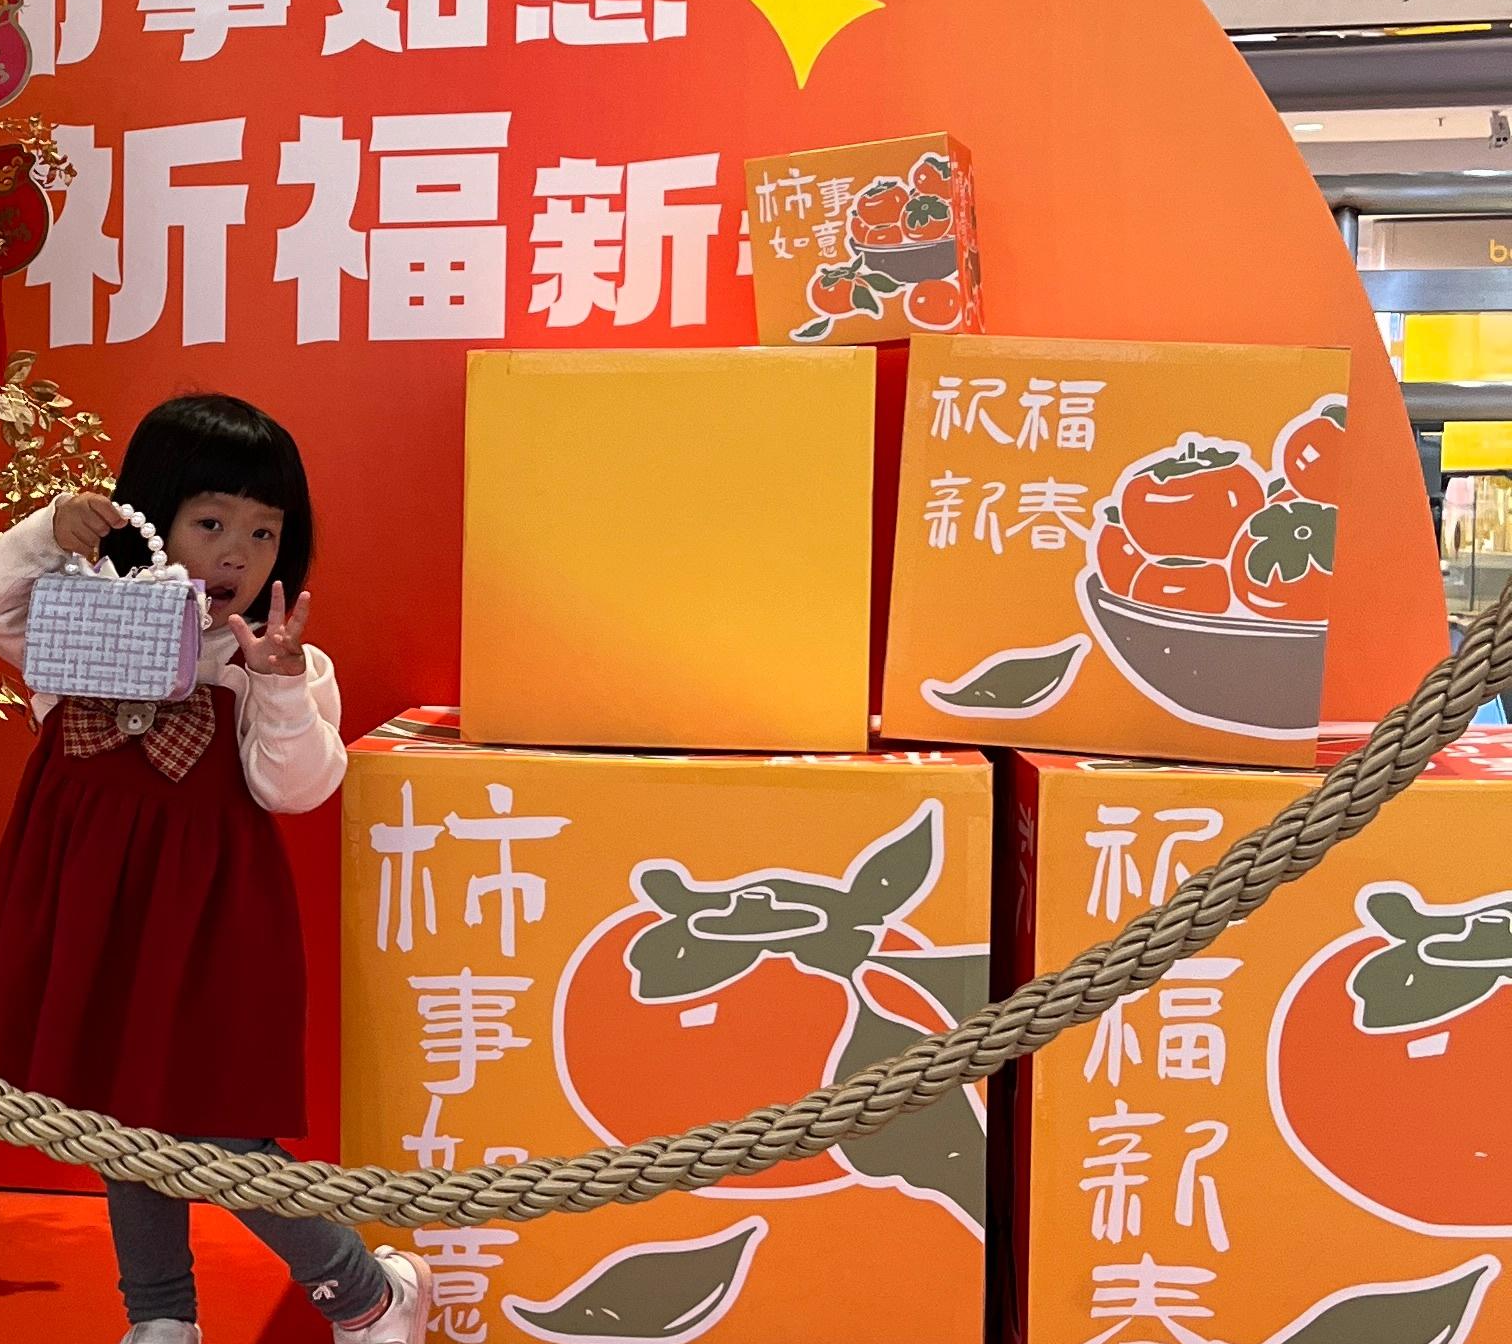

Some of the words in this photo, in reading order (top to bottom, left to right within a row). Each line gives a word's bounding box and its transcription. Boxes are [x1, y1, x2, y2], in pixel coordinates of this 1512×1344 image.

[24, 110, 754, 349] 祈福新
[754, 167, 856, 224] 柿事
[768, 219, 845, 260] 如意
[922, 468, 1090, 555] 新春
